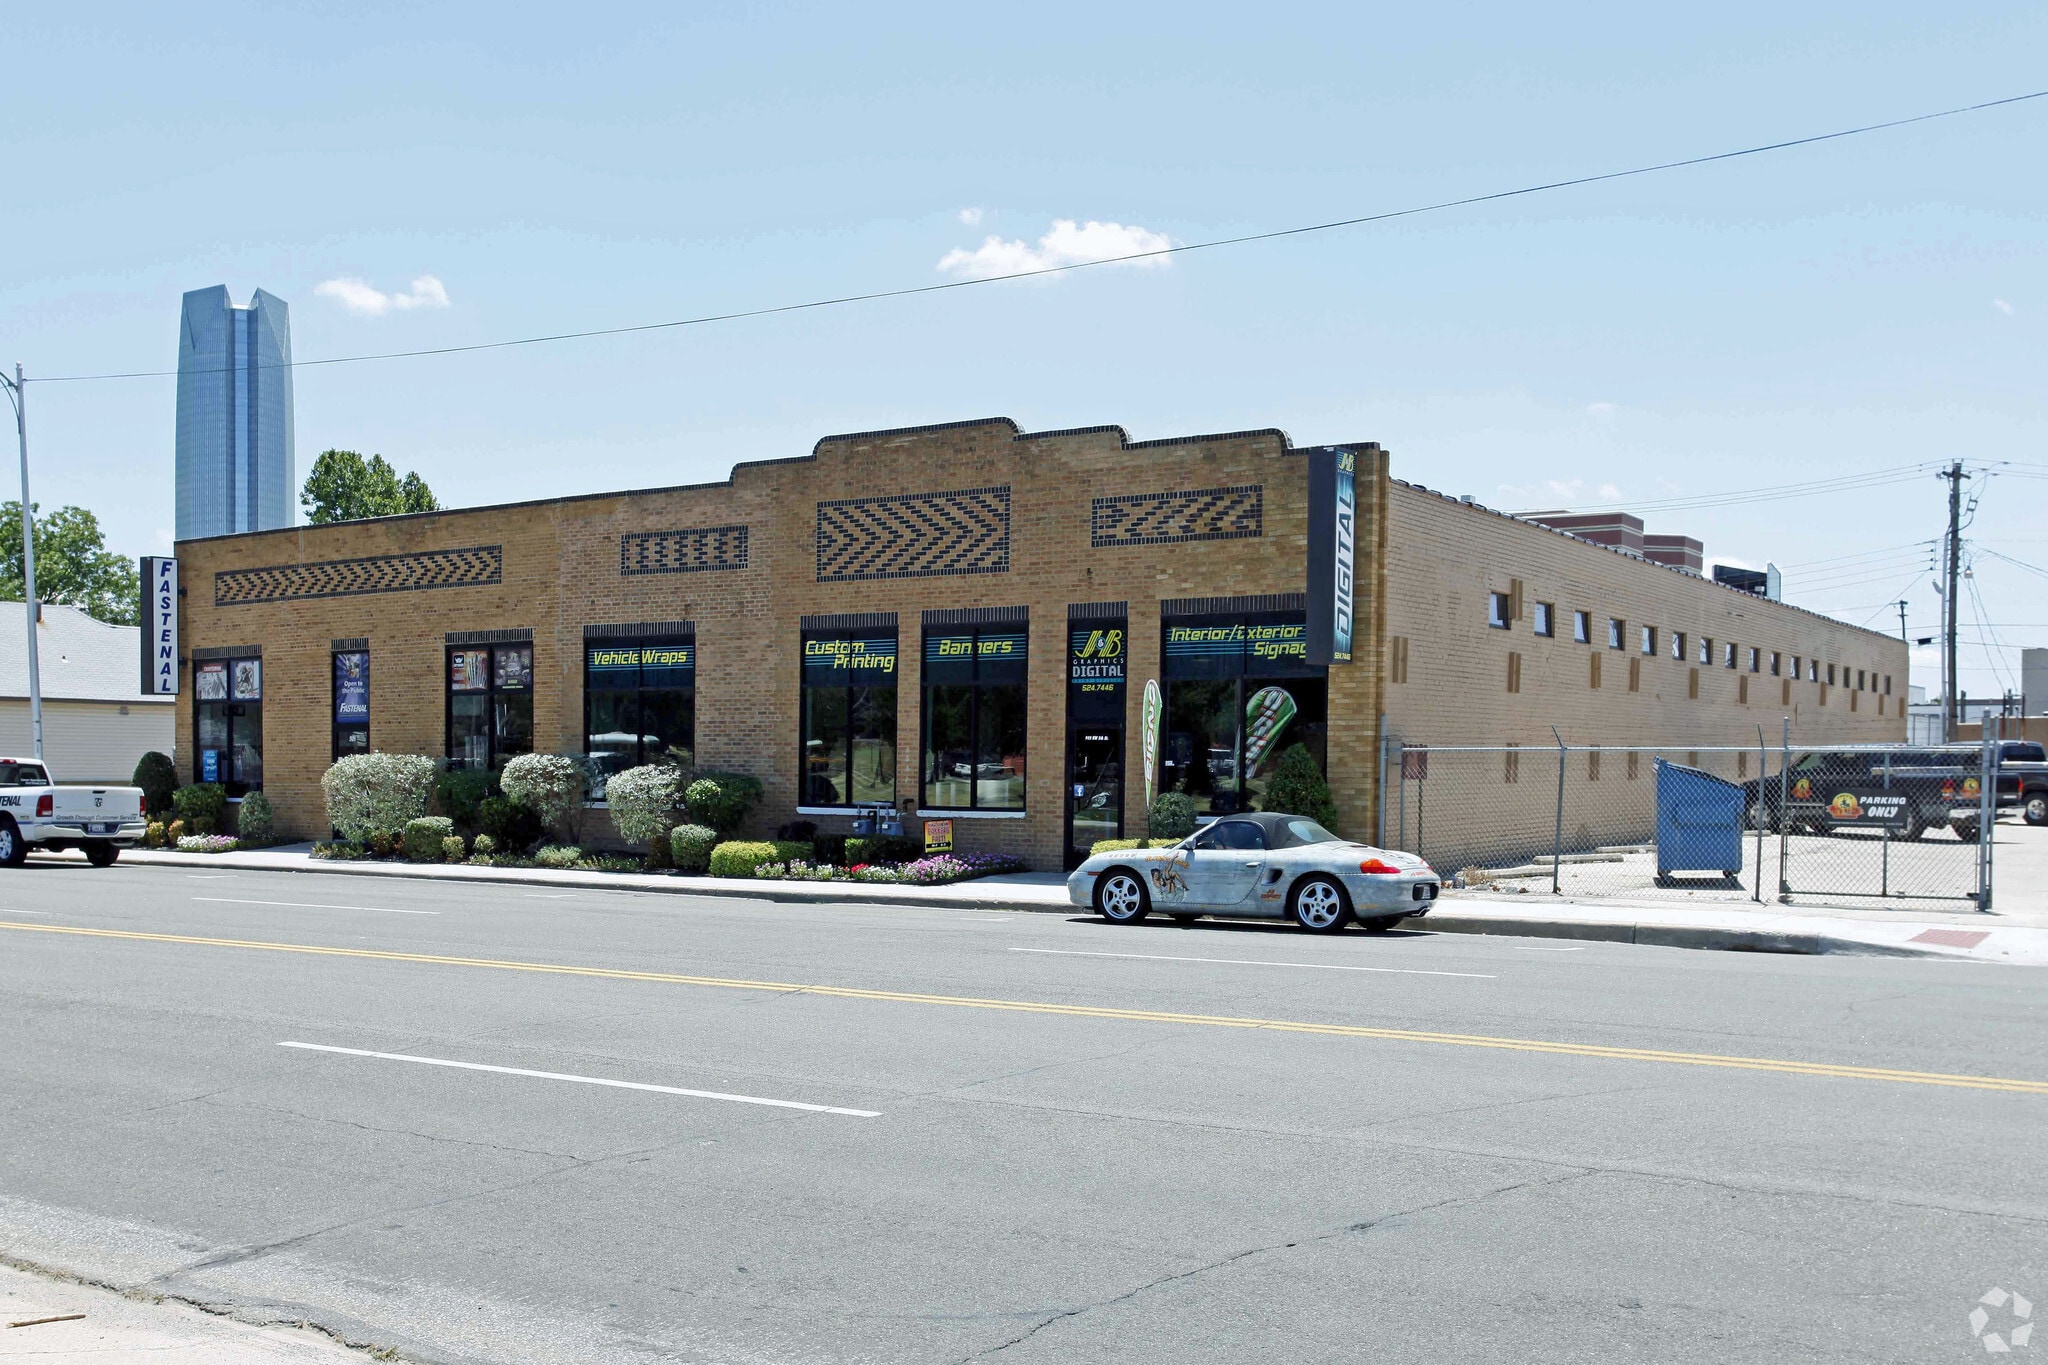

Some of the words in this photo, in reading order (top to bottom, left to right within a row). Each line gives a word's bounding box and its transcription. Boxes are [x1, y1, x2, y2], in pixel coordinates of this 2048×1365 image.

[1337, 493, 1352, 637] DIGITAL
[160, 561, 173, 692] FASTENAL
[805, 639, 865, 655] Custom
[938, 639, 1013, 655] Banners
[1253, 641, 1306, 660] Signag
[594, 650, 639, 665] Vehicle
[641, 649, 687, 666] Wraps
[833, 653, 895, 673] Printing
[1072, 665, 1124, 677] DIGITAL
[344, 680, 357, 688] Open
[1082, 684, 1114, 692] 524.7446
[340, 702, 367, 713] FASTENAL
[1859, 796, 1907, 805] PARKING
[1867, 806, 1899, 818] ONLY
